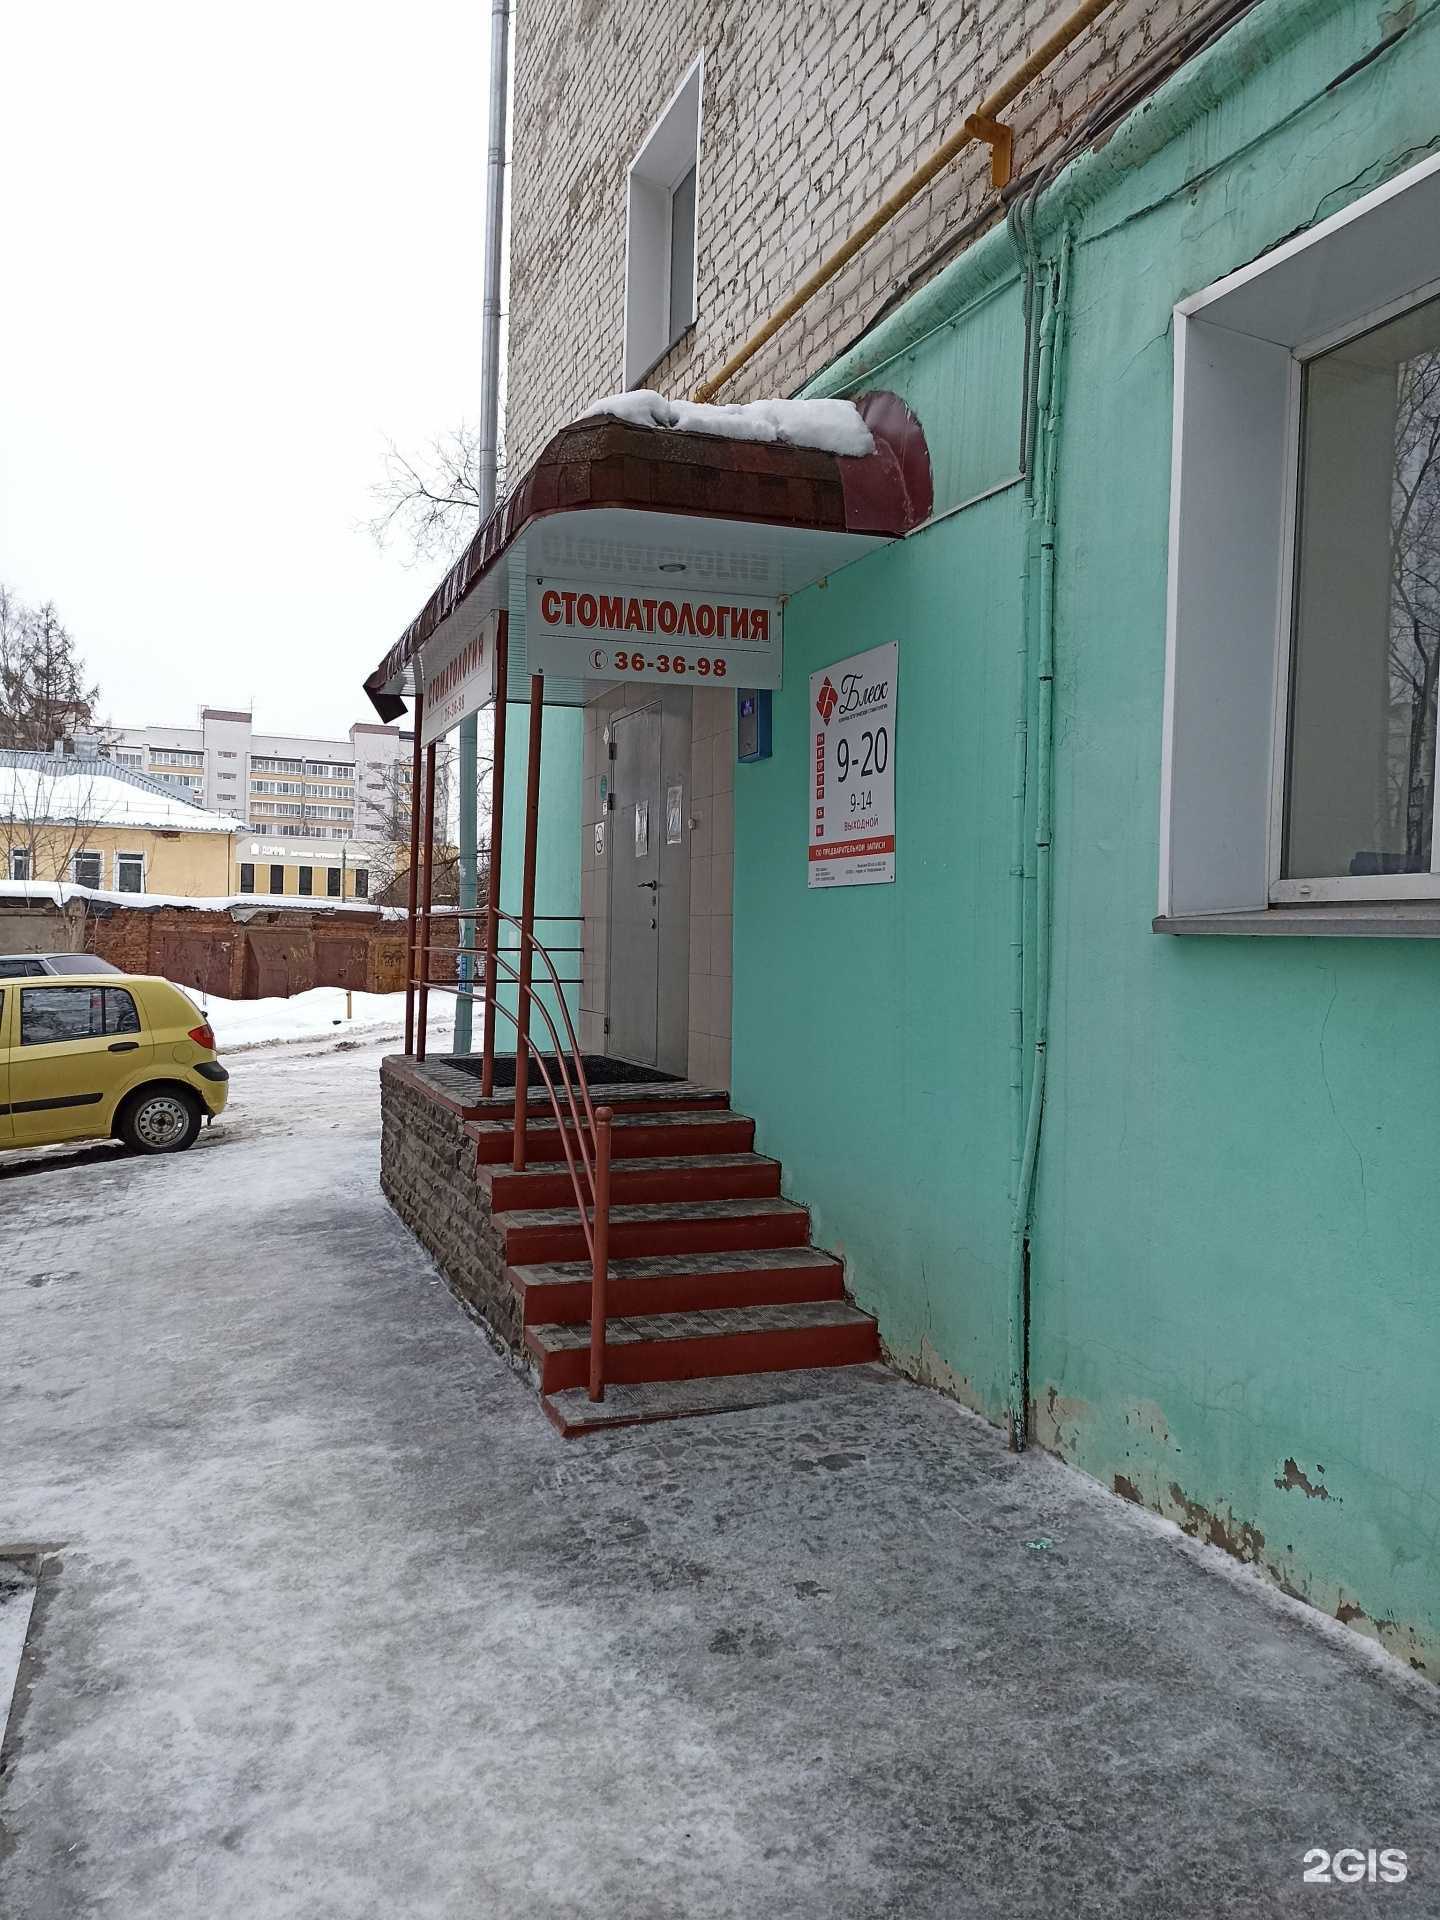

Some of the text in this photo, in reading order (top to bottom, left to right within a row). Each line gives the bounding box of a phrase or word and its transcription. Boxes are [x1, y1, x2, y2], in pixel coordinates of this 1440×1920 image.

[541, 590, 770, 642] СТОМАТОЛОГИЯ
[614, 651, 727, 677] 36-36-98
[839, 674, 888, 714] Блеск
[837, 727, 888, 783] 9-20
[850, 790, 872, 812] 9-14
[844, 815, 879, 831] ВЫХОДНОЙ
